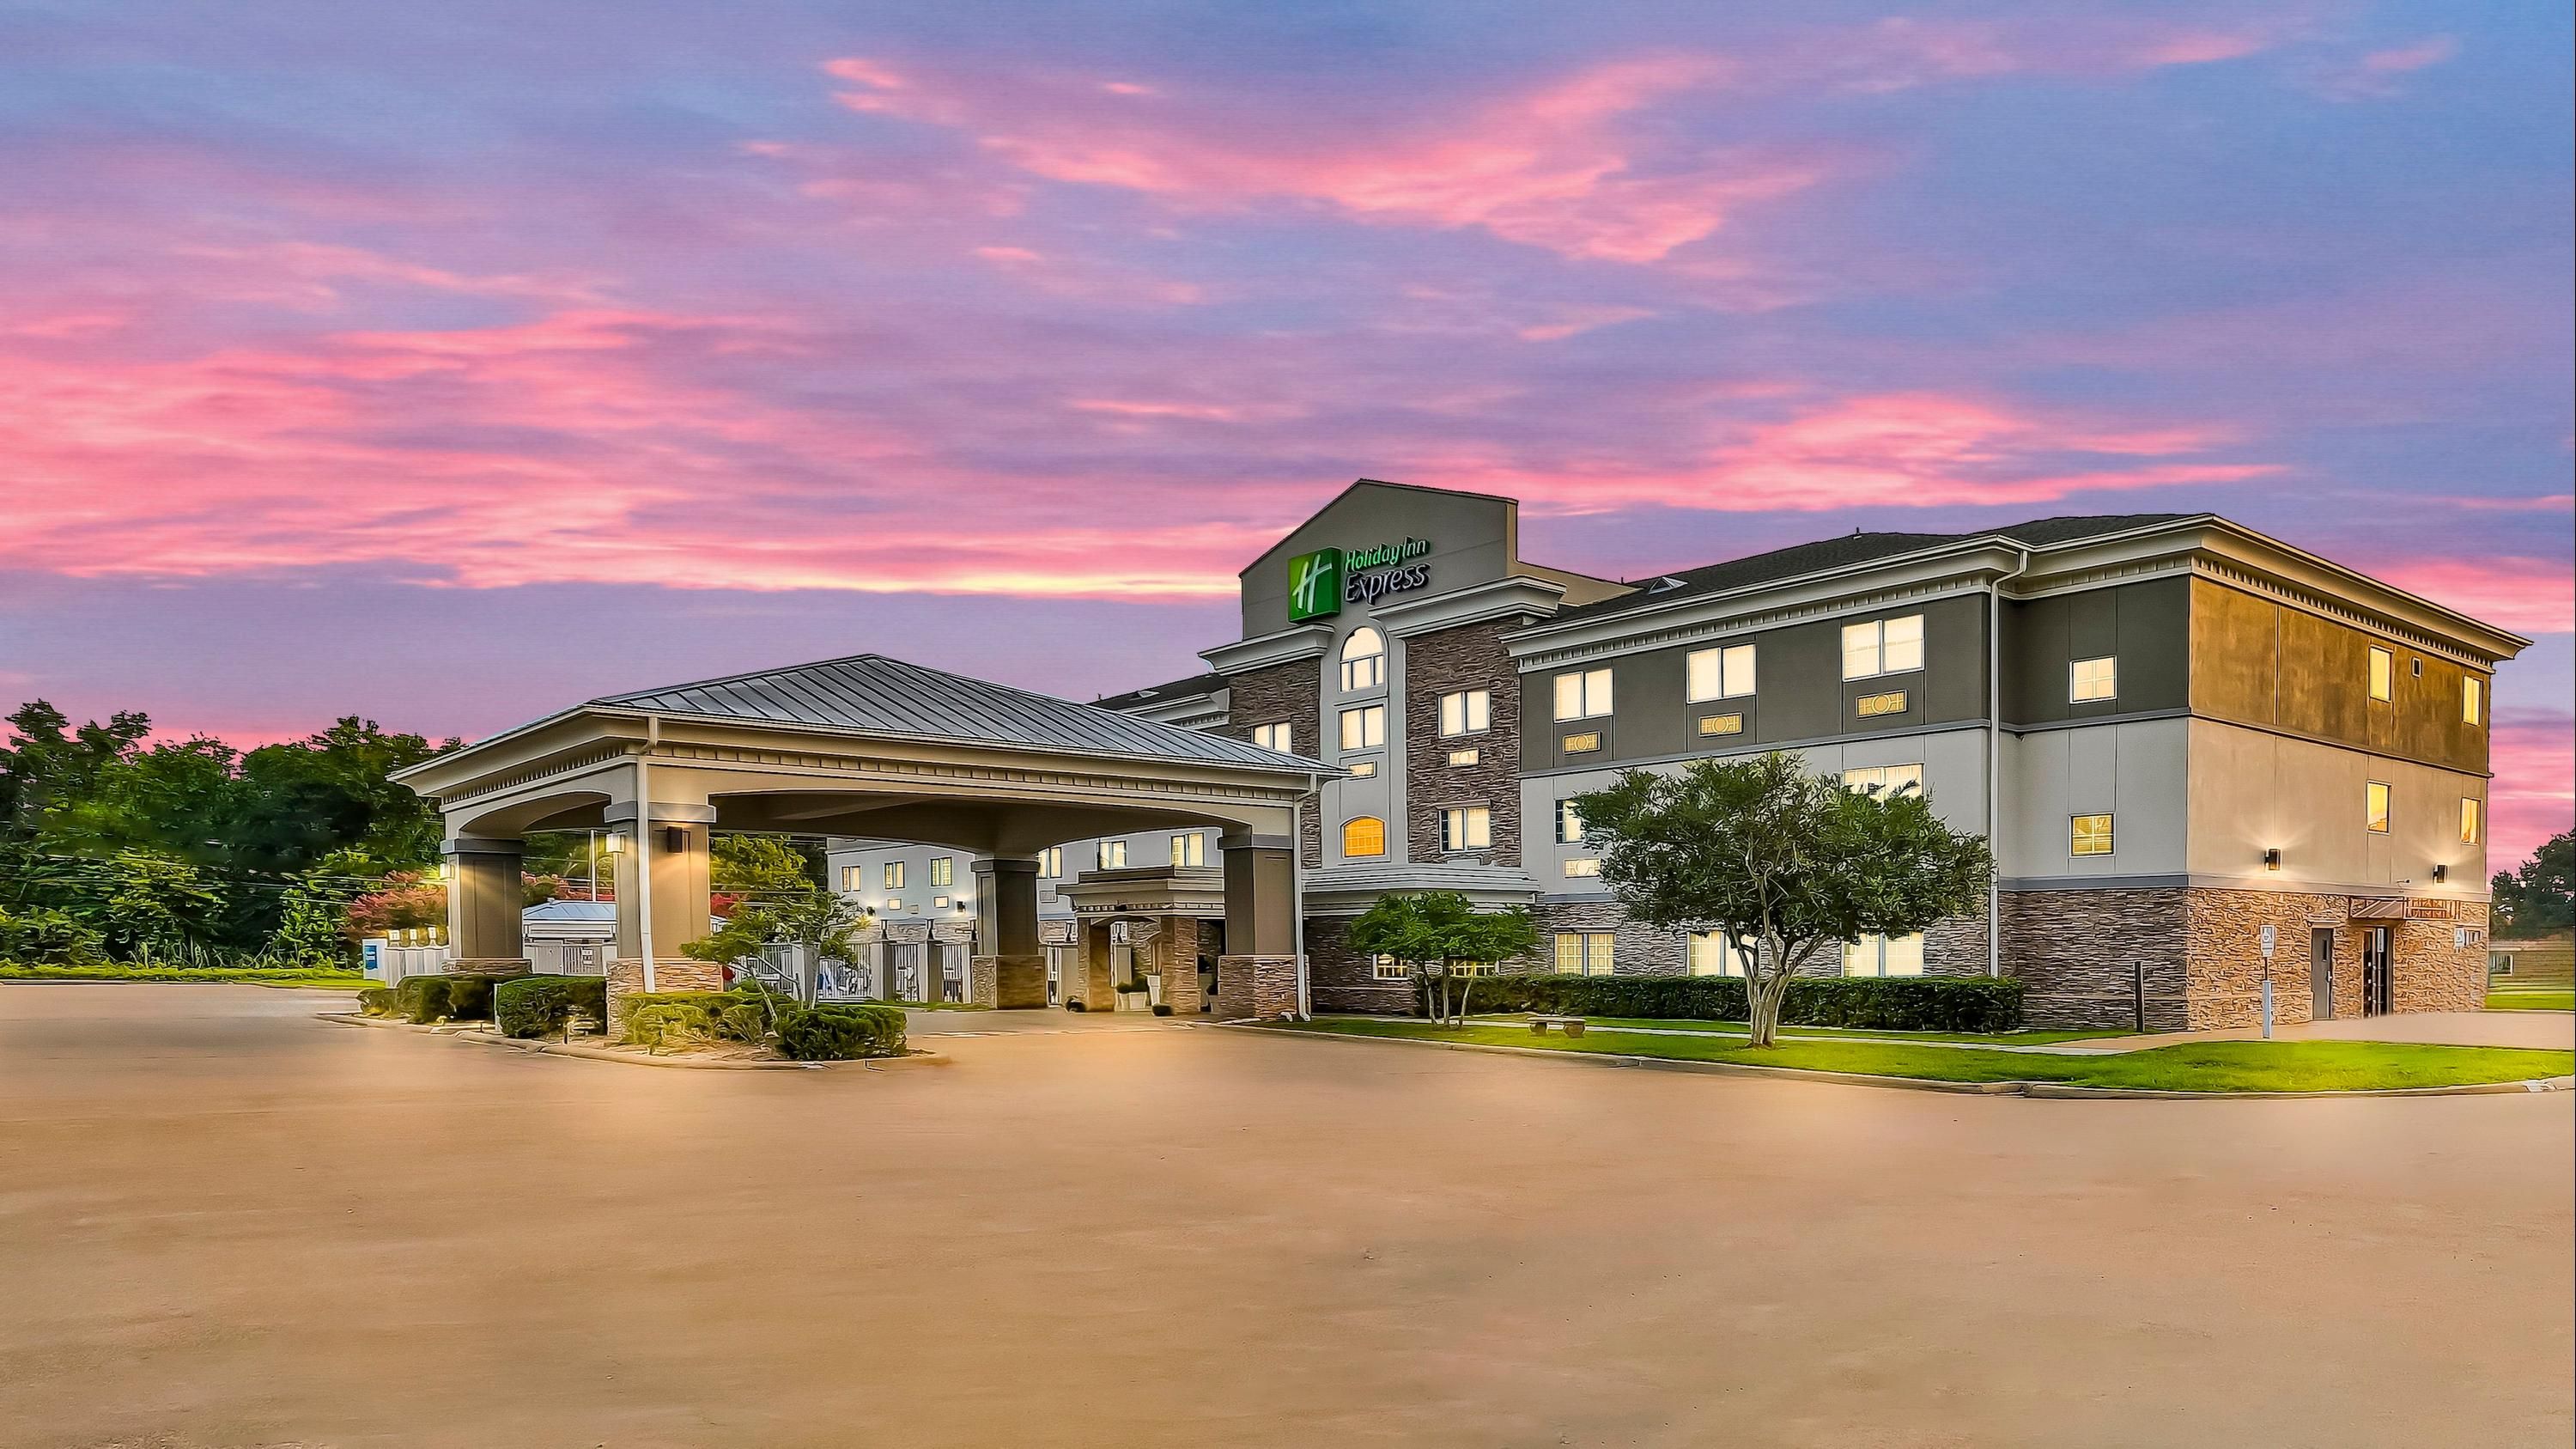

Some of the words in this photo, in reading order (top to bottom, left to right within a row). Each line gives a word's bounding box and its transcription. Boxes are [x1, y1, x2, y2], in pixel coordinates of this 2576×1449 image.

[1345, 542, 1401, 573] Holiday
[1401, 535, 1430, 559] Inn
[1291, 553, 1333, 613] H
[1345, 563, 1430, 605] Express
